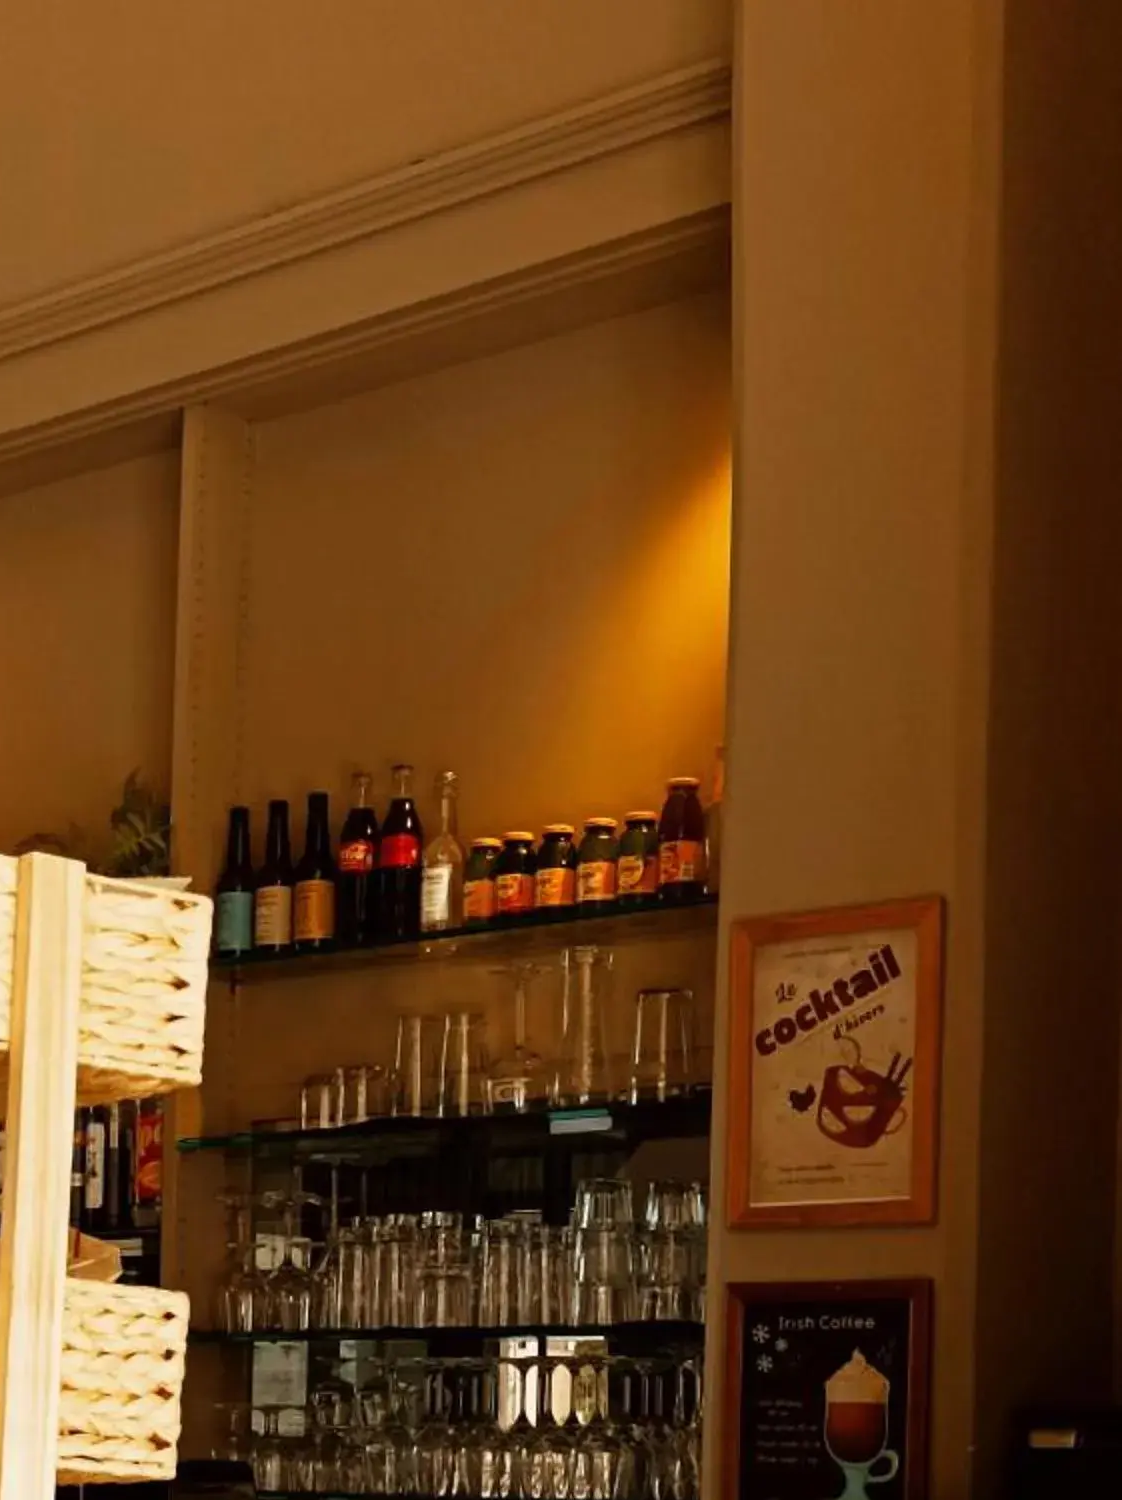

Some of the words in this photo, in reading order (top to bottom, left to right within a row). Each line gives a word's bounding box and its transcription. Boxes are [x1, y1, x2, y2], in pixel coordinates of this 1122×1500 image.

[755, 944, 901, 1056] cocktail
[779, 1316, 814, 1331] Irish
[819, 1315, 876, 1330] Coffee
